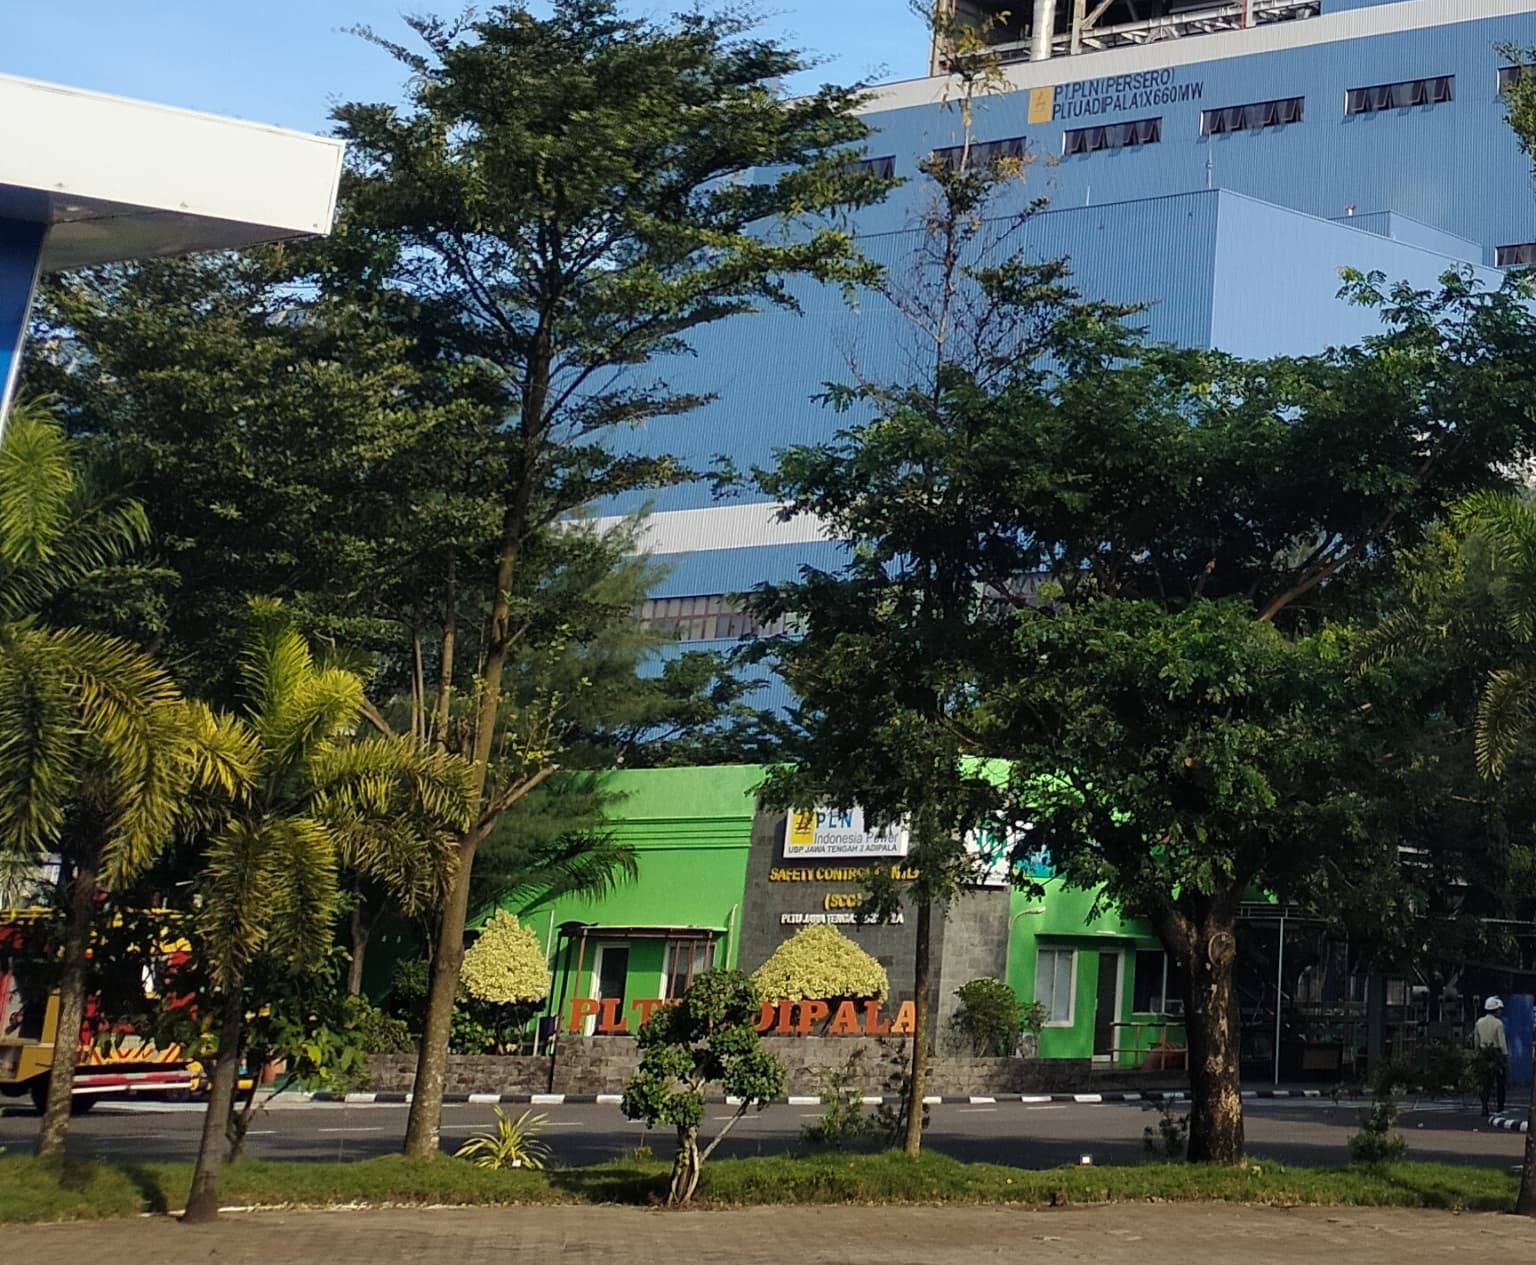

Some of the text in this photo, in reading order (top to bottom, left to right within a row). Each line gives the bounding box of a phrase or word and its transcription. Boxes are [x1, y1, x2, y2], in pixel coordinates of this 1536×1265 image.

[816, 811, 853, 828] PLN
[814, 833, 862, 844] Indonesia
[805, 845, 825, 853] JAWA
[828, 845, 858, 853] TENGAH
[865, 844, 897, 852] ADIPALA
[769, 867, 814, 881] SAFETY
[827, 913, 860, 924] TENGA
[566, 998, 916, 1033] PLT DIPALA
